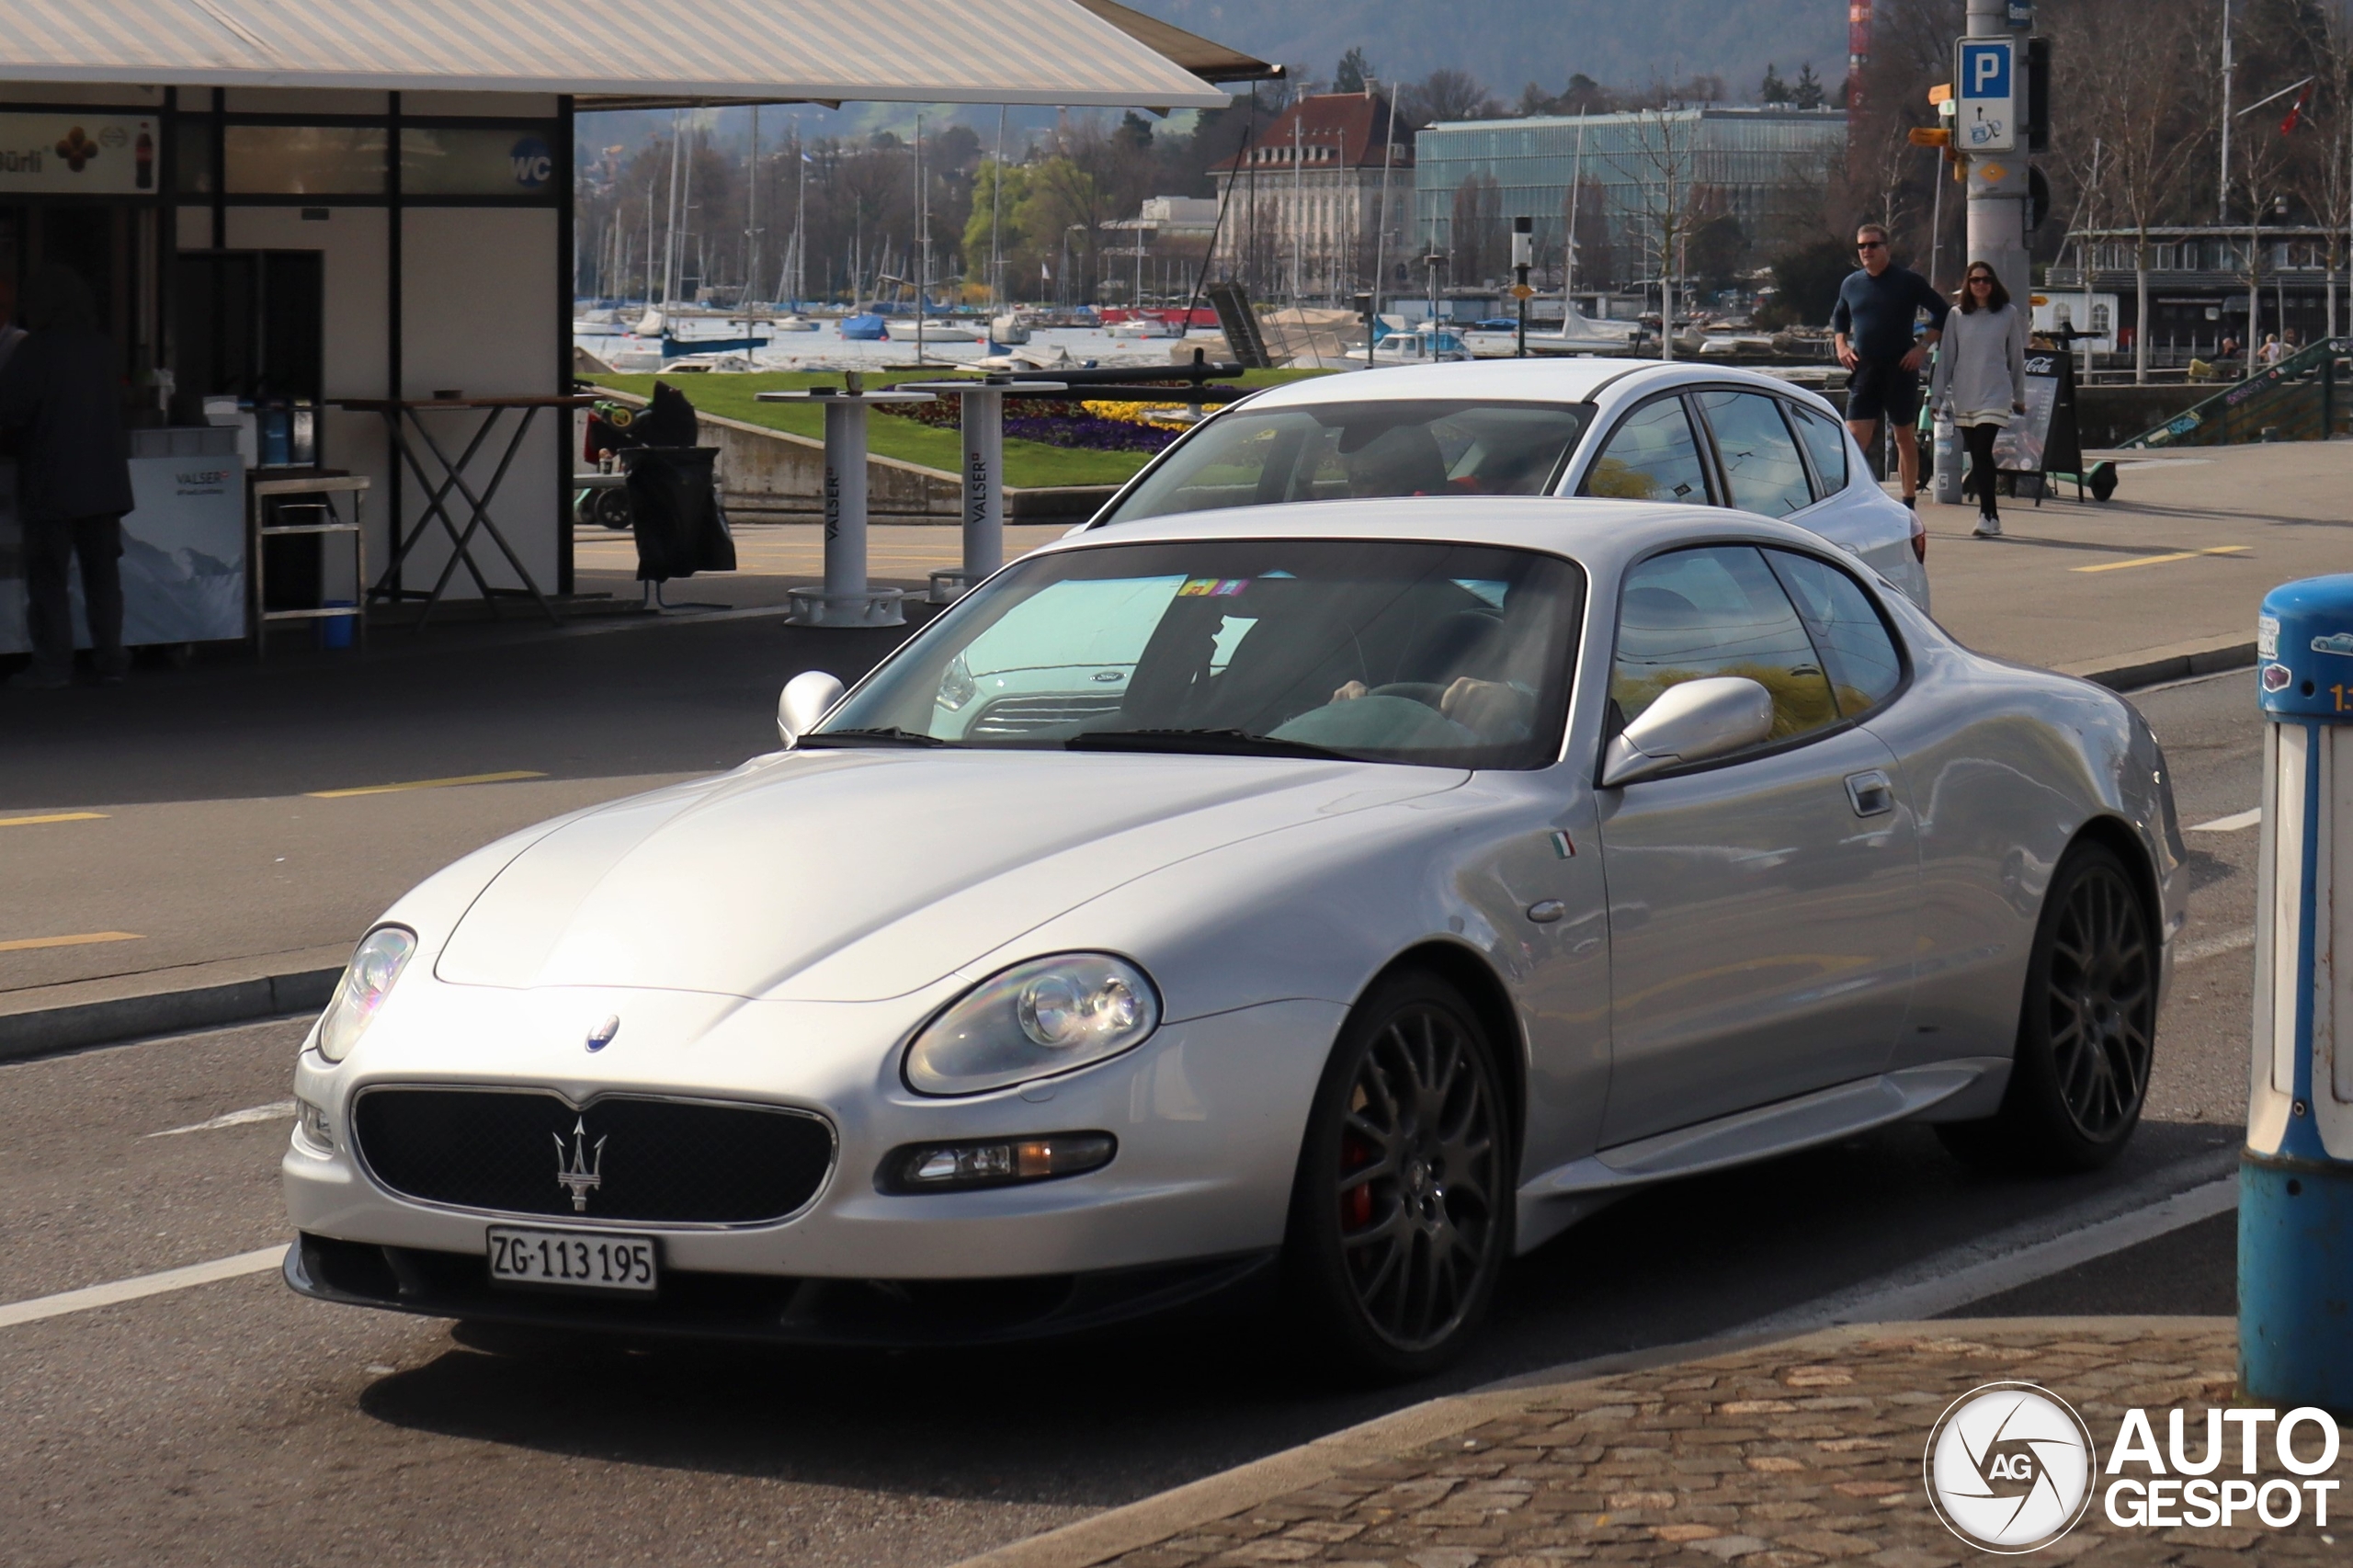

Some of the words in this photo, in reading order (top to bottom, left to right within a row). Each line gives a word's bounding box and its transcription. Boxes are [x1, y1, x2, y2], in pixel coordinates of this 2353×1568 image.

[1975, 52, 1999, 93] P
[509, 156, 551, 181] WC
[175, 471, 223, 485] VALSER
[972, 461, 986, 524] VALSER
[826, 476, 839, 541] VALSER
